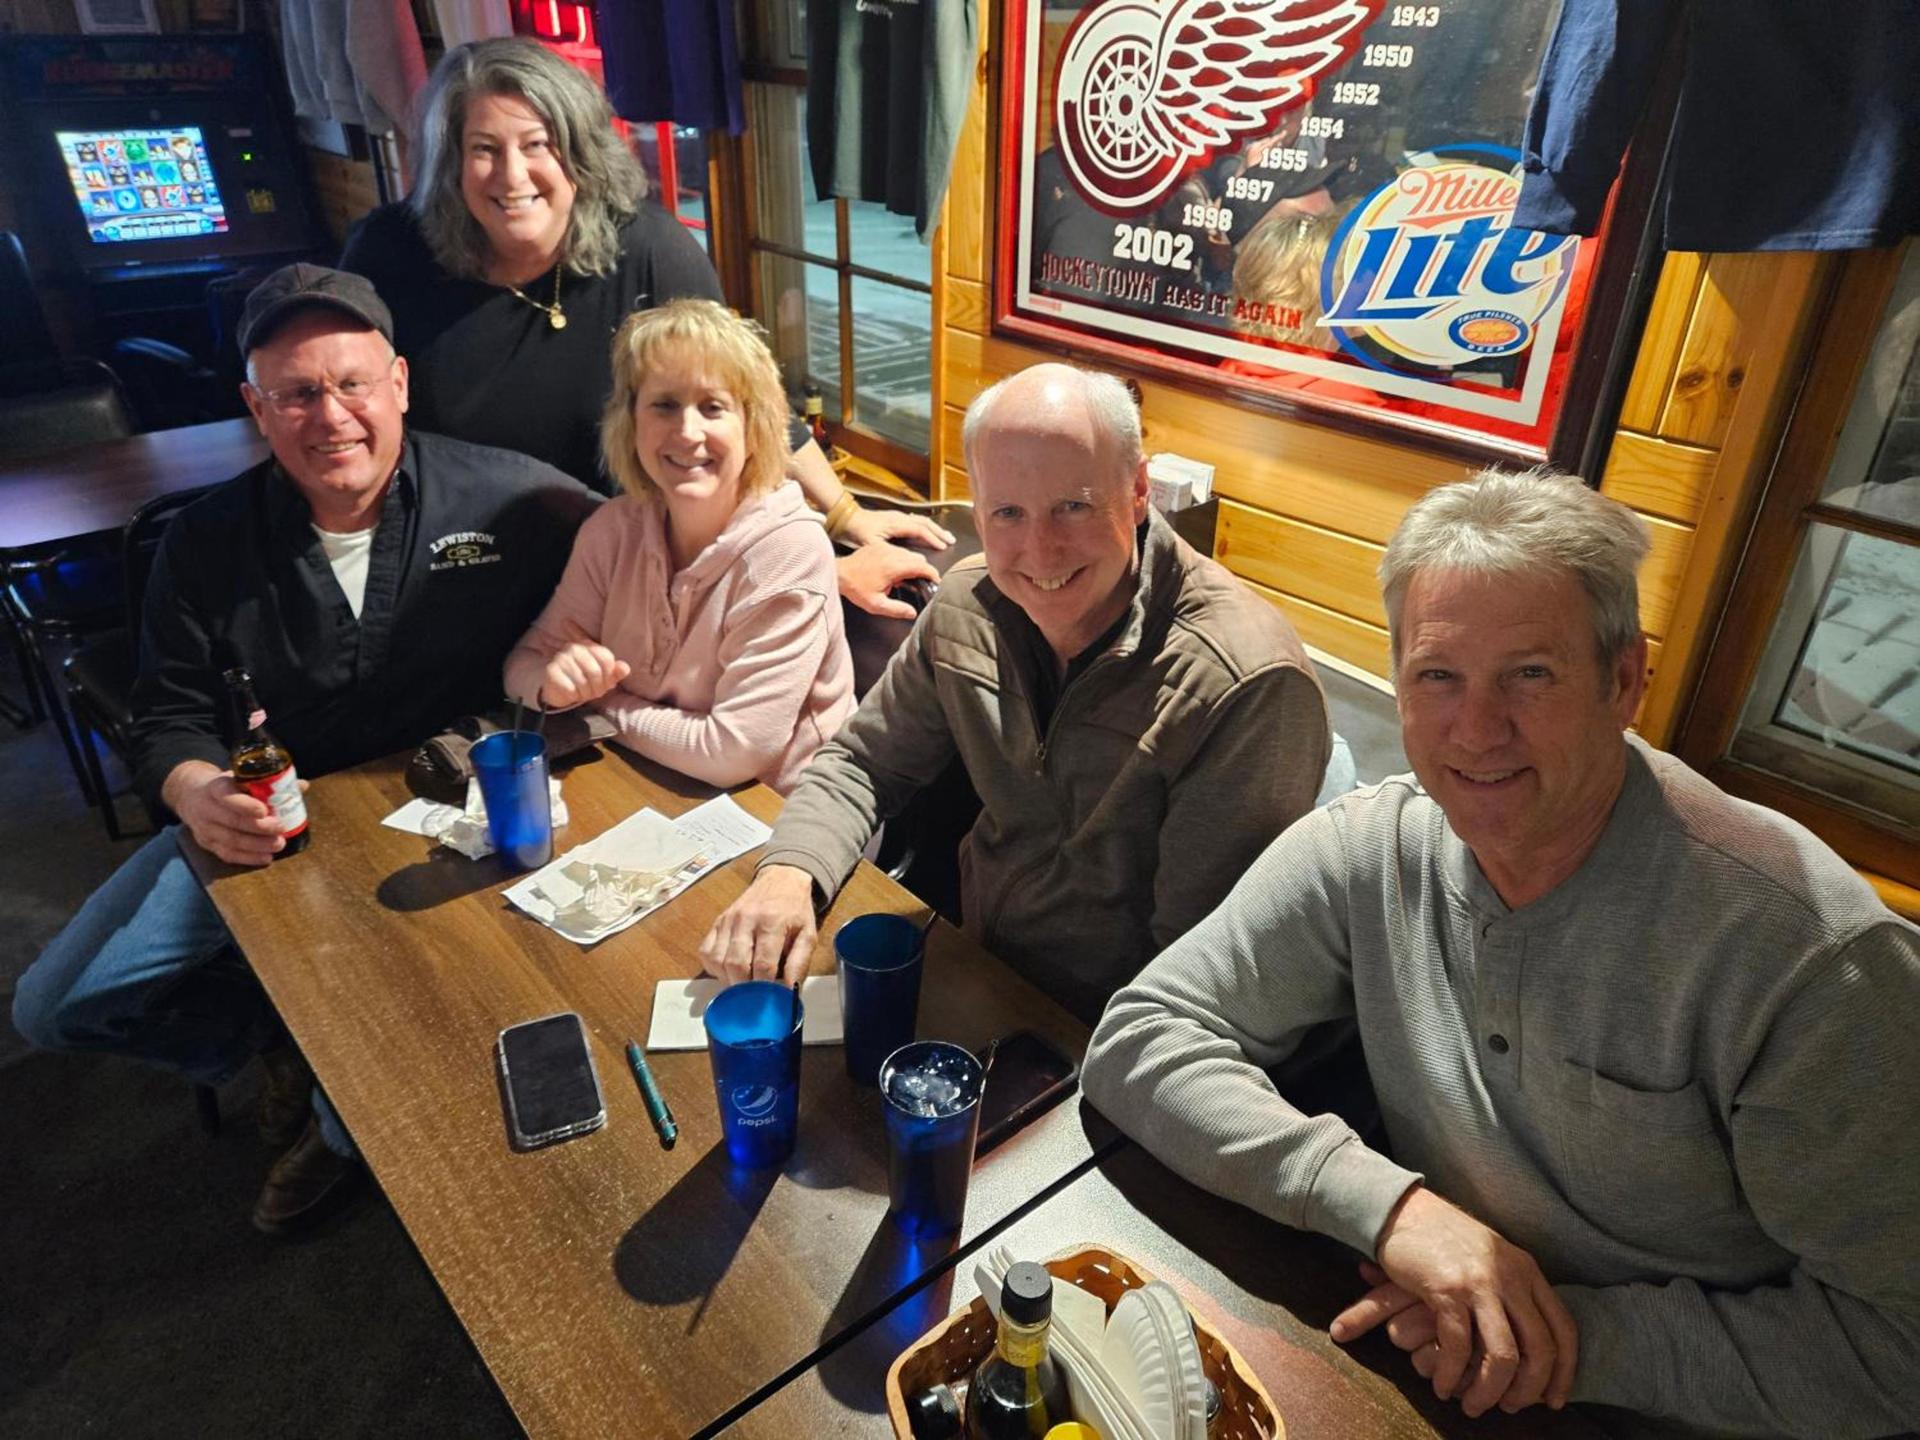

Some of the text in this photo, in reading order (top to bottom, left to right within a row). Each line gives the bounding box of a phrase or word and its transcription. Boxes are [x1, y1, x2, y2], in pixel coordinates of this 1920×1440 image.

[1391, 5, 1440, 27] 1943
[1362, 44, 1414, 68] 1950
[1332, 81, 1381, 106] 1952
[1300, 116, 1344, 139] 1954
[1259, 147, 1309, 172] 1955
[1225, 175, 1275, 203] 1997
[1400, 168, 1519, 216] Mille
[1182, 202, 1234, 232] 1998
[1112, 223, 1195, 271] 2002
[1324, 214, 1572, 321] Lite
[1162, 283, 1206, 313] HAS
[1207, 290, 1232, 318] IT
[1231, 295, 1304, 331] AGAIN
[1458, 311, 1483, 325] TRUE
[1467, 343, 1505, 353] BEER
[429, 531, 496, 554] LEWISTON
[737, 1115, 775, 1127] pepsi
